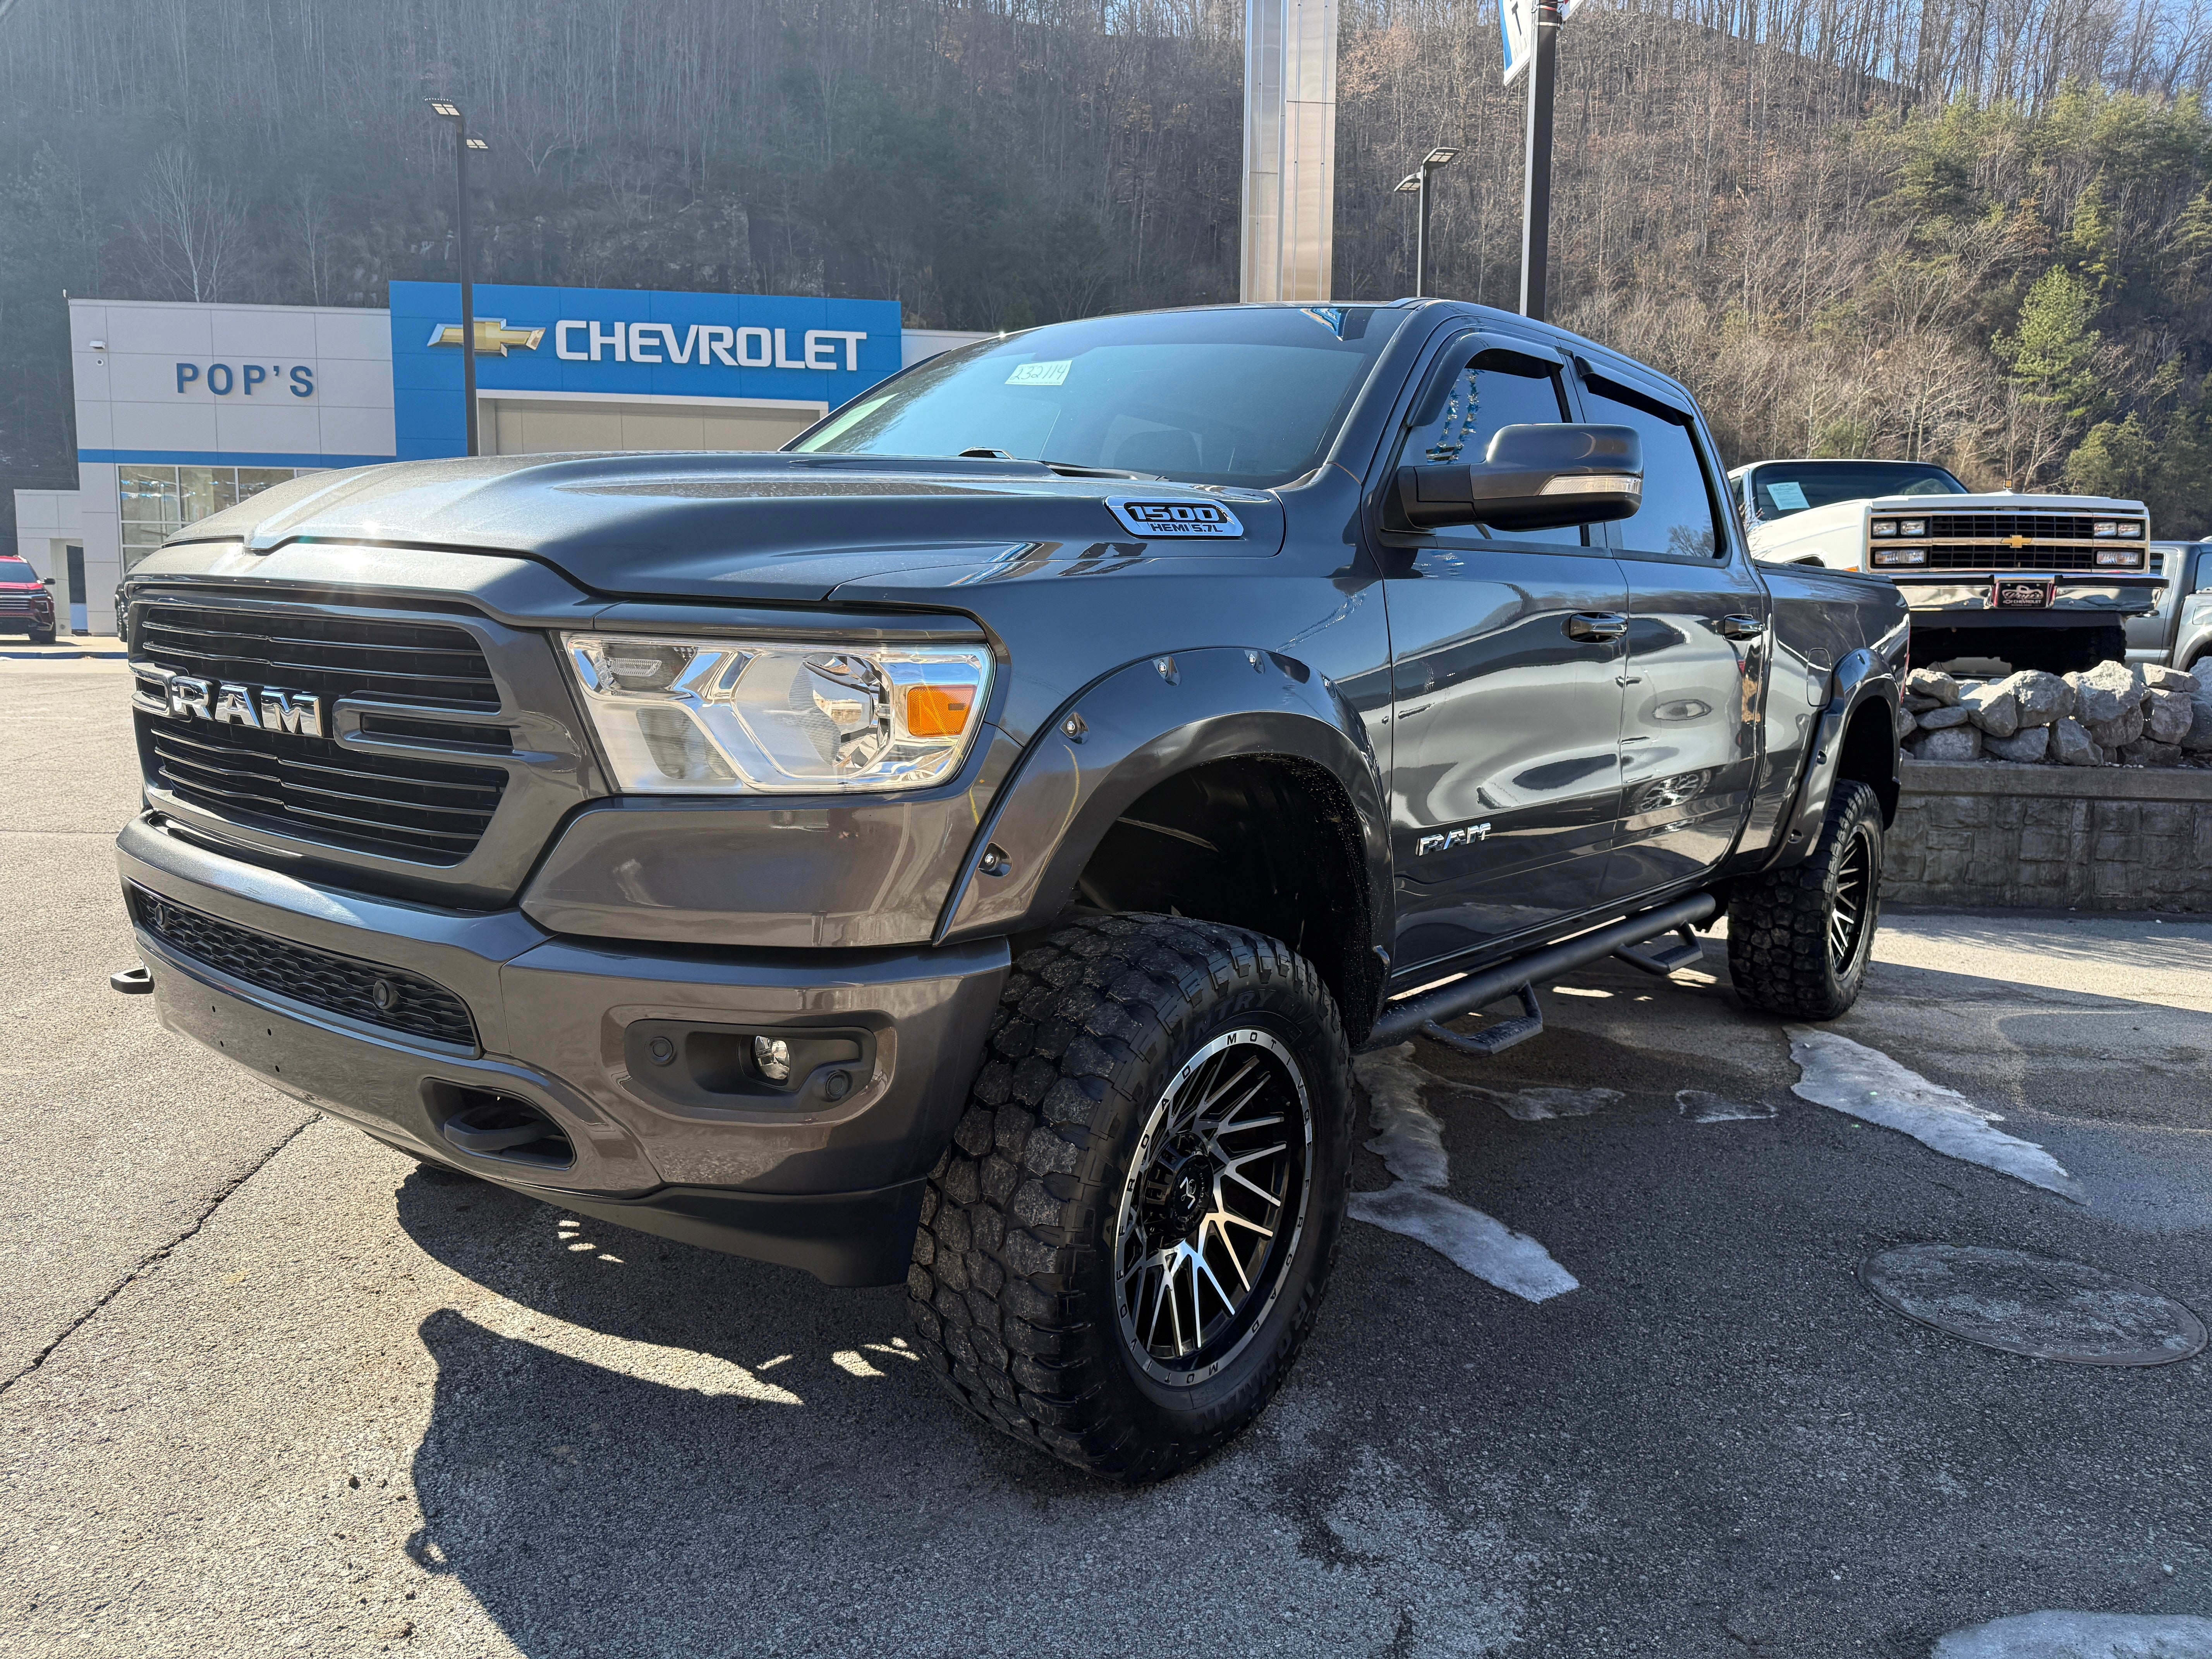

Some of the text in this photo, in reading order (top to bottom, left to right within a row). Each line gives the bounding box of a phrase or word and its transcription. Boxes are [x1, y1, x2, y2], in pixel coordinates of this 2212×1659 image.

[555, 319, 867, 371] CHEVROLET
[176, 363, 314, 397] POP'S
[1010, 364, 1068, 380] 232114
[1128, 506, 1219, 521] 1500
[1152, 523, 1223, 532] HEMI 5.7L
[172, 676, 324, 737] RAM
[1415, 822, 1492, 856] RAM
